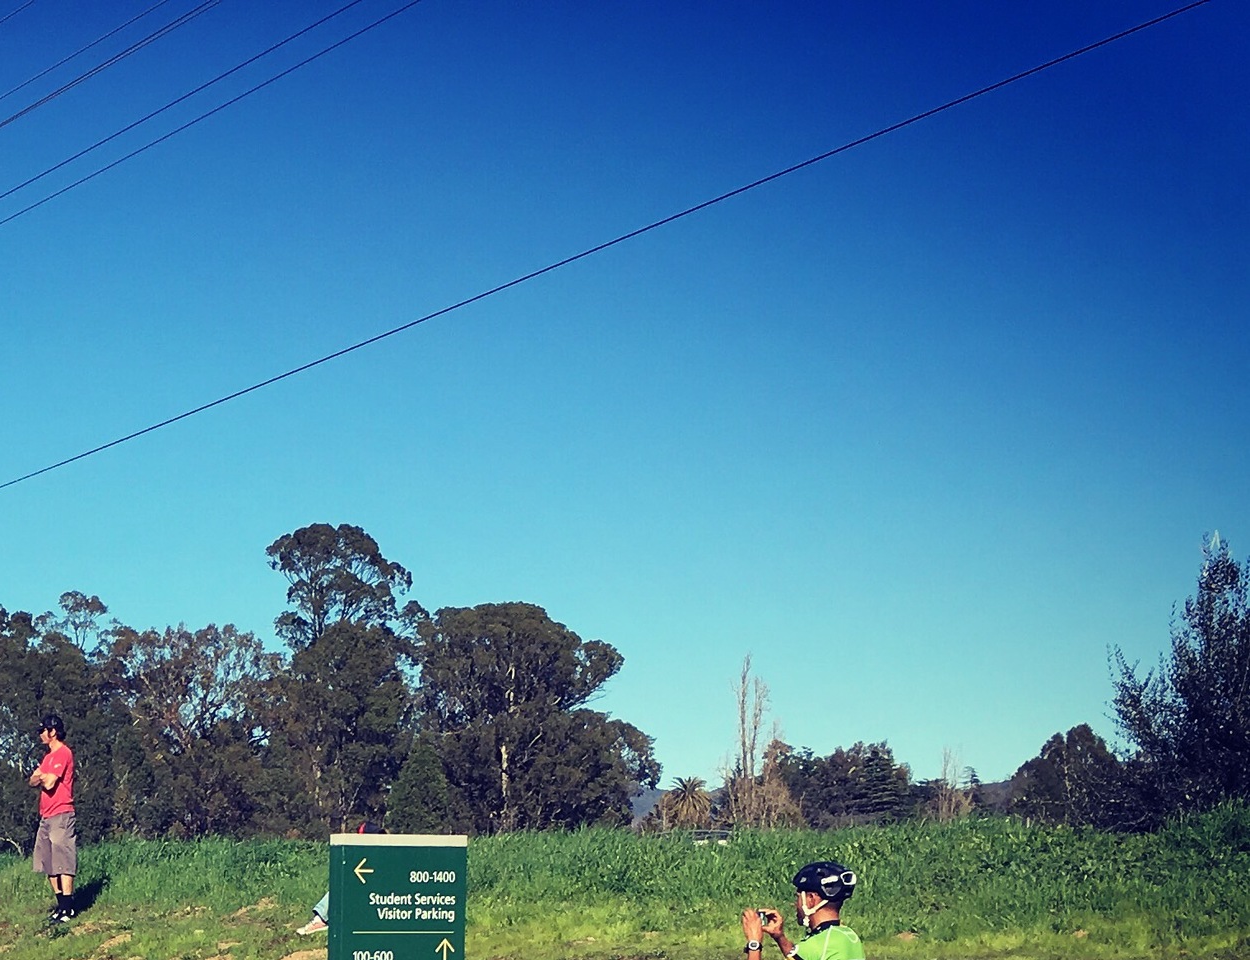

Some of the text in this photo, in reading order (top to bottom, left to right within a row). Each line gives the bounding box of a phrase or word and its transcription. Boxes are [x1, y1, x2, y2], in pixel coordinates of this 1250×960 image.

[409, 871, 456, 883] 800-1400
[369, 893, 456, 905] Student Services
[377, 908, 456, 922] Visitor Parking
